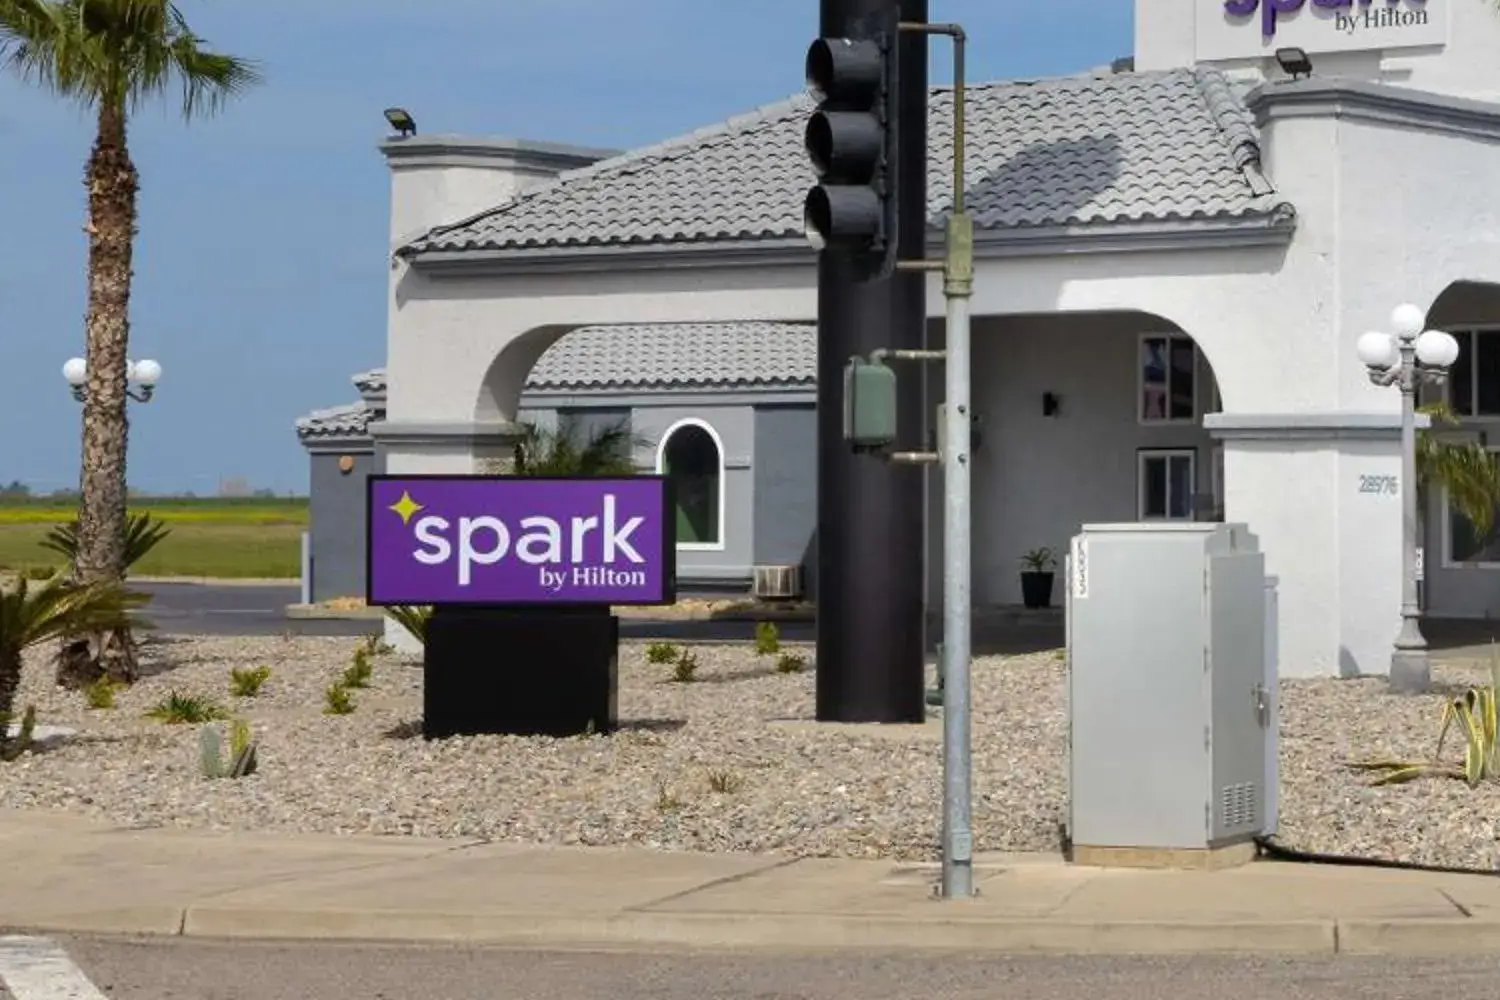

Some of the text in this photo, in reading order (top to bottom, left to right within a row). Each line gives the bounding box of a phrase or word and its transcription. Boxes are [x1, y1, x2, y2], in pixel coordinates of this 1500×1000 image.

[1335, 8, 1428, 34] by Hilton
[413, 494, 646, 585] spark
[539, 567, 646, 591] by Hilton
